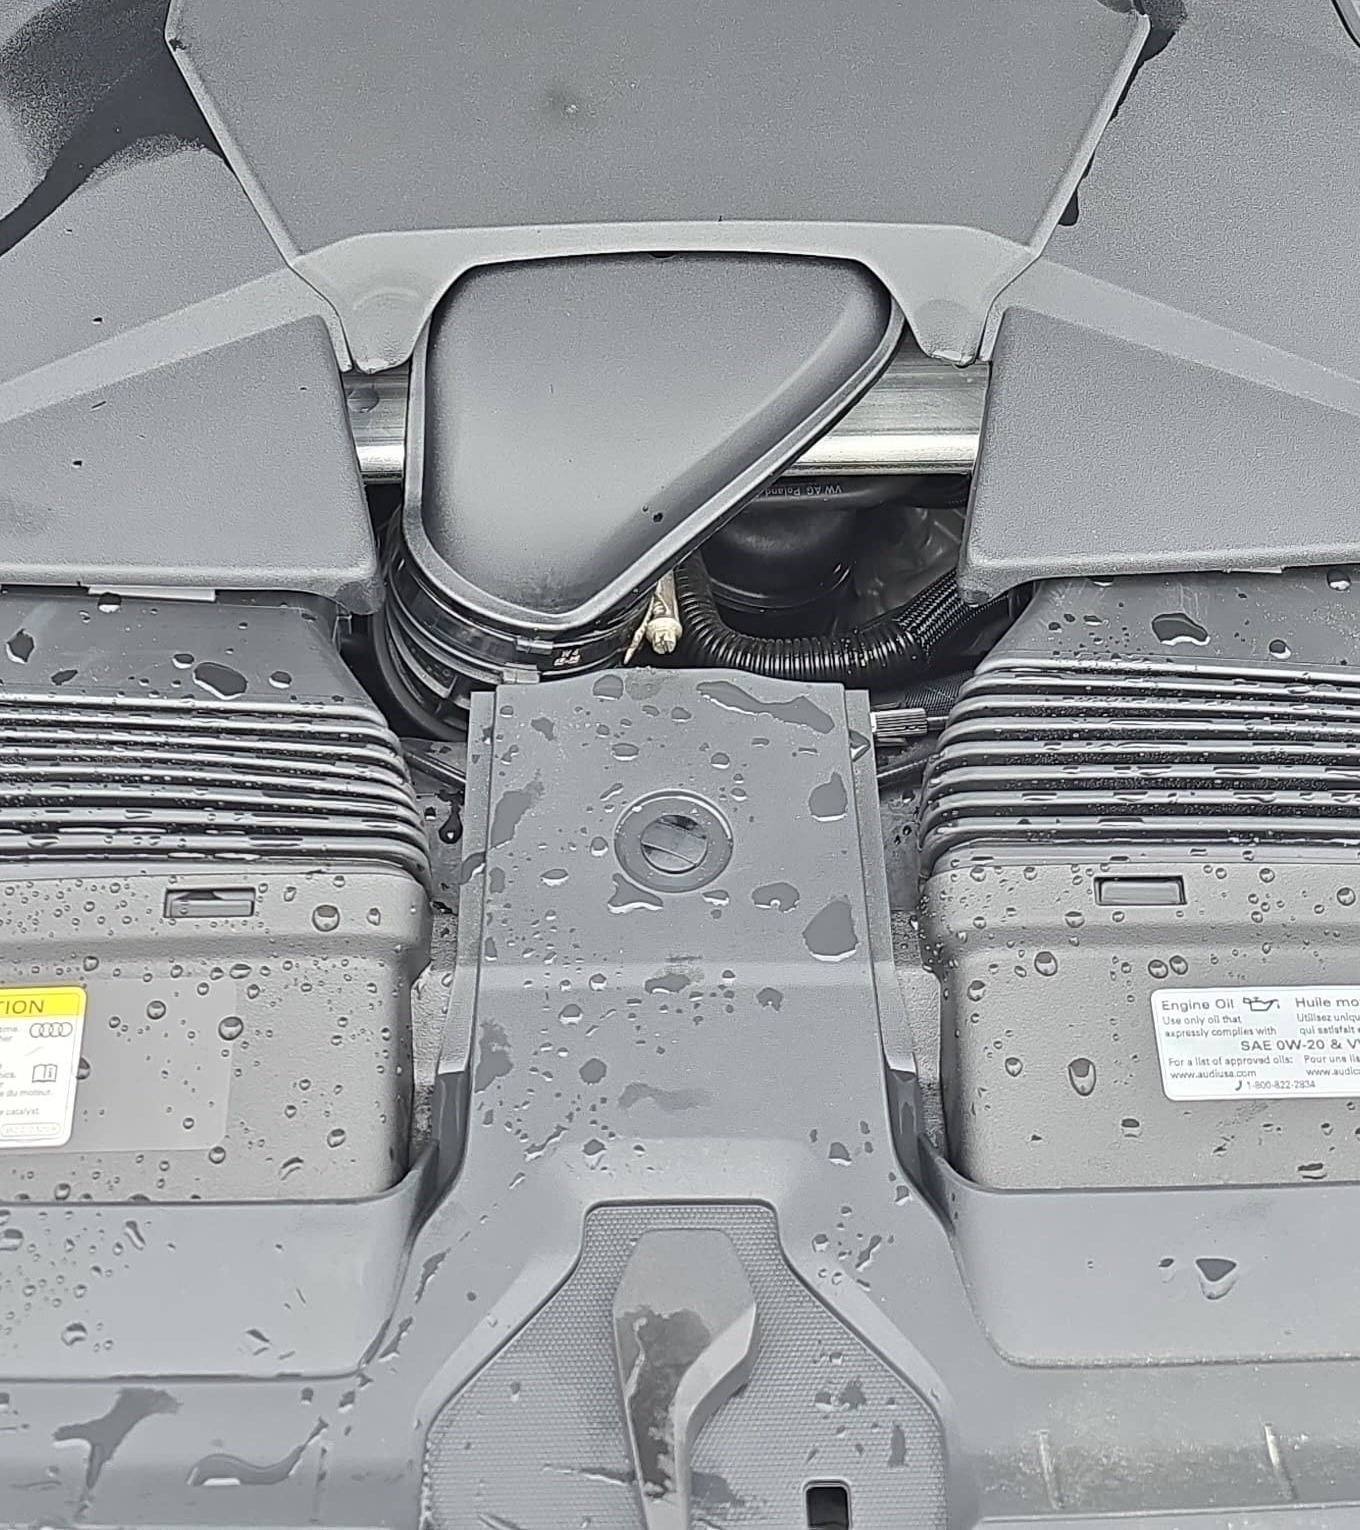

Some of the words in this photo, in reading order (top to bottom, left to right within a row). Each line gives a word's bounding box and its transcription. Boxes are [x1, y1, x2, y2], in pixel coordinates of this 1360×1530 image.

[1161, 1000, 1210, 1012] Engine
[1215, 999, 1234, 1009] Oil
[1296, 997, 1331, 1007] Huile
[1163, 1017, 1181, 1025] Use
[1184, 1016, 1205, 1026] only
[1222, 1015, 1241, 1023] that
[1257, 1026, 1276, 1035] with
[1241, 1041, 1272, 1051] SAE
[1276, 1039, 1325, 1050] 0W-20
[1331, 1039, 1342, 1049] &
